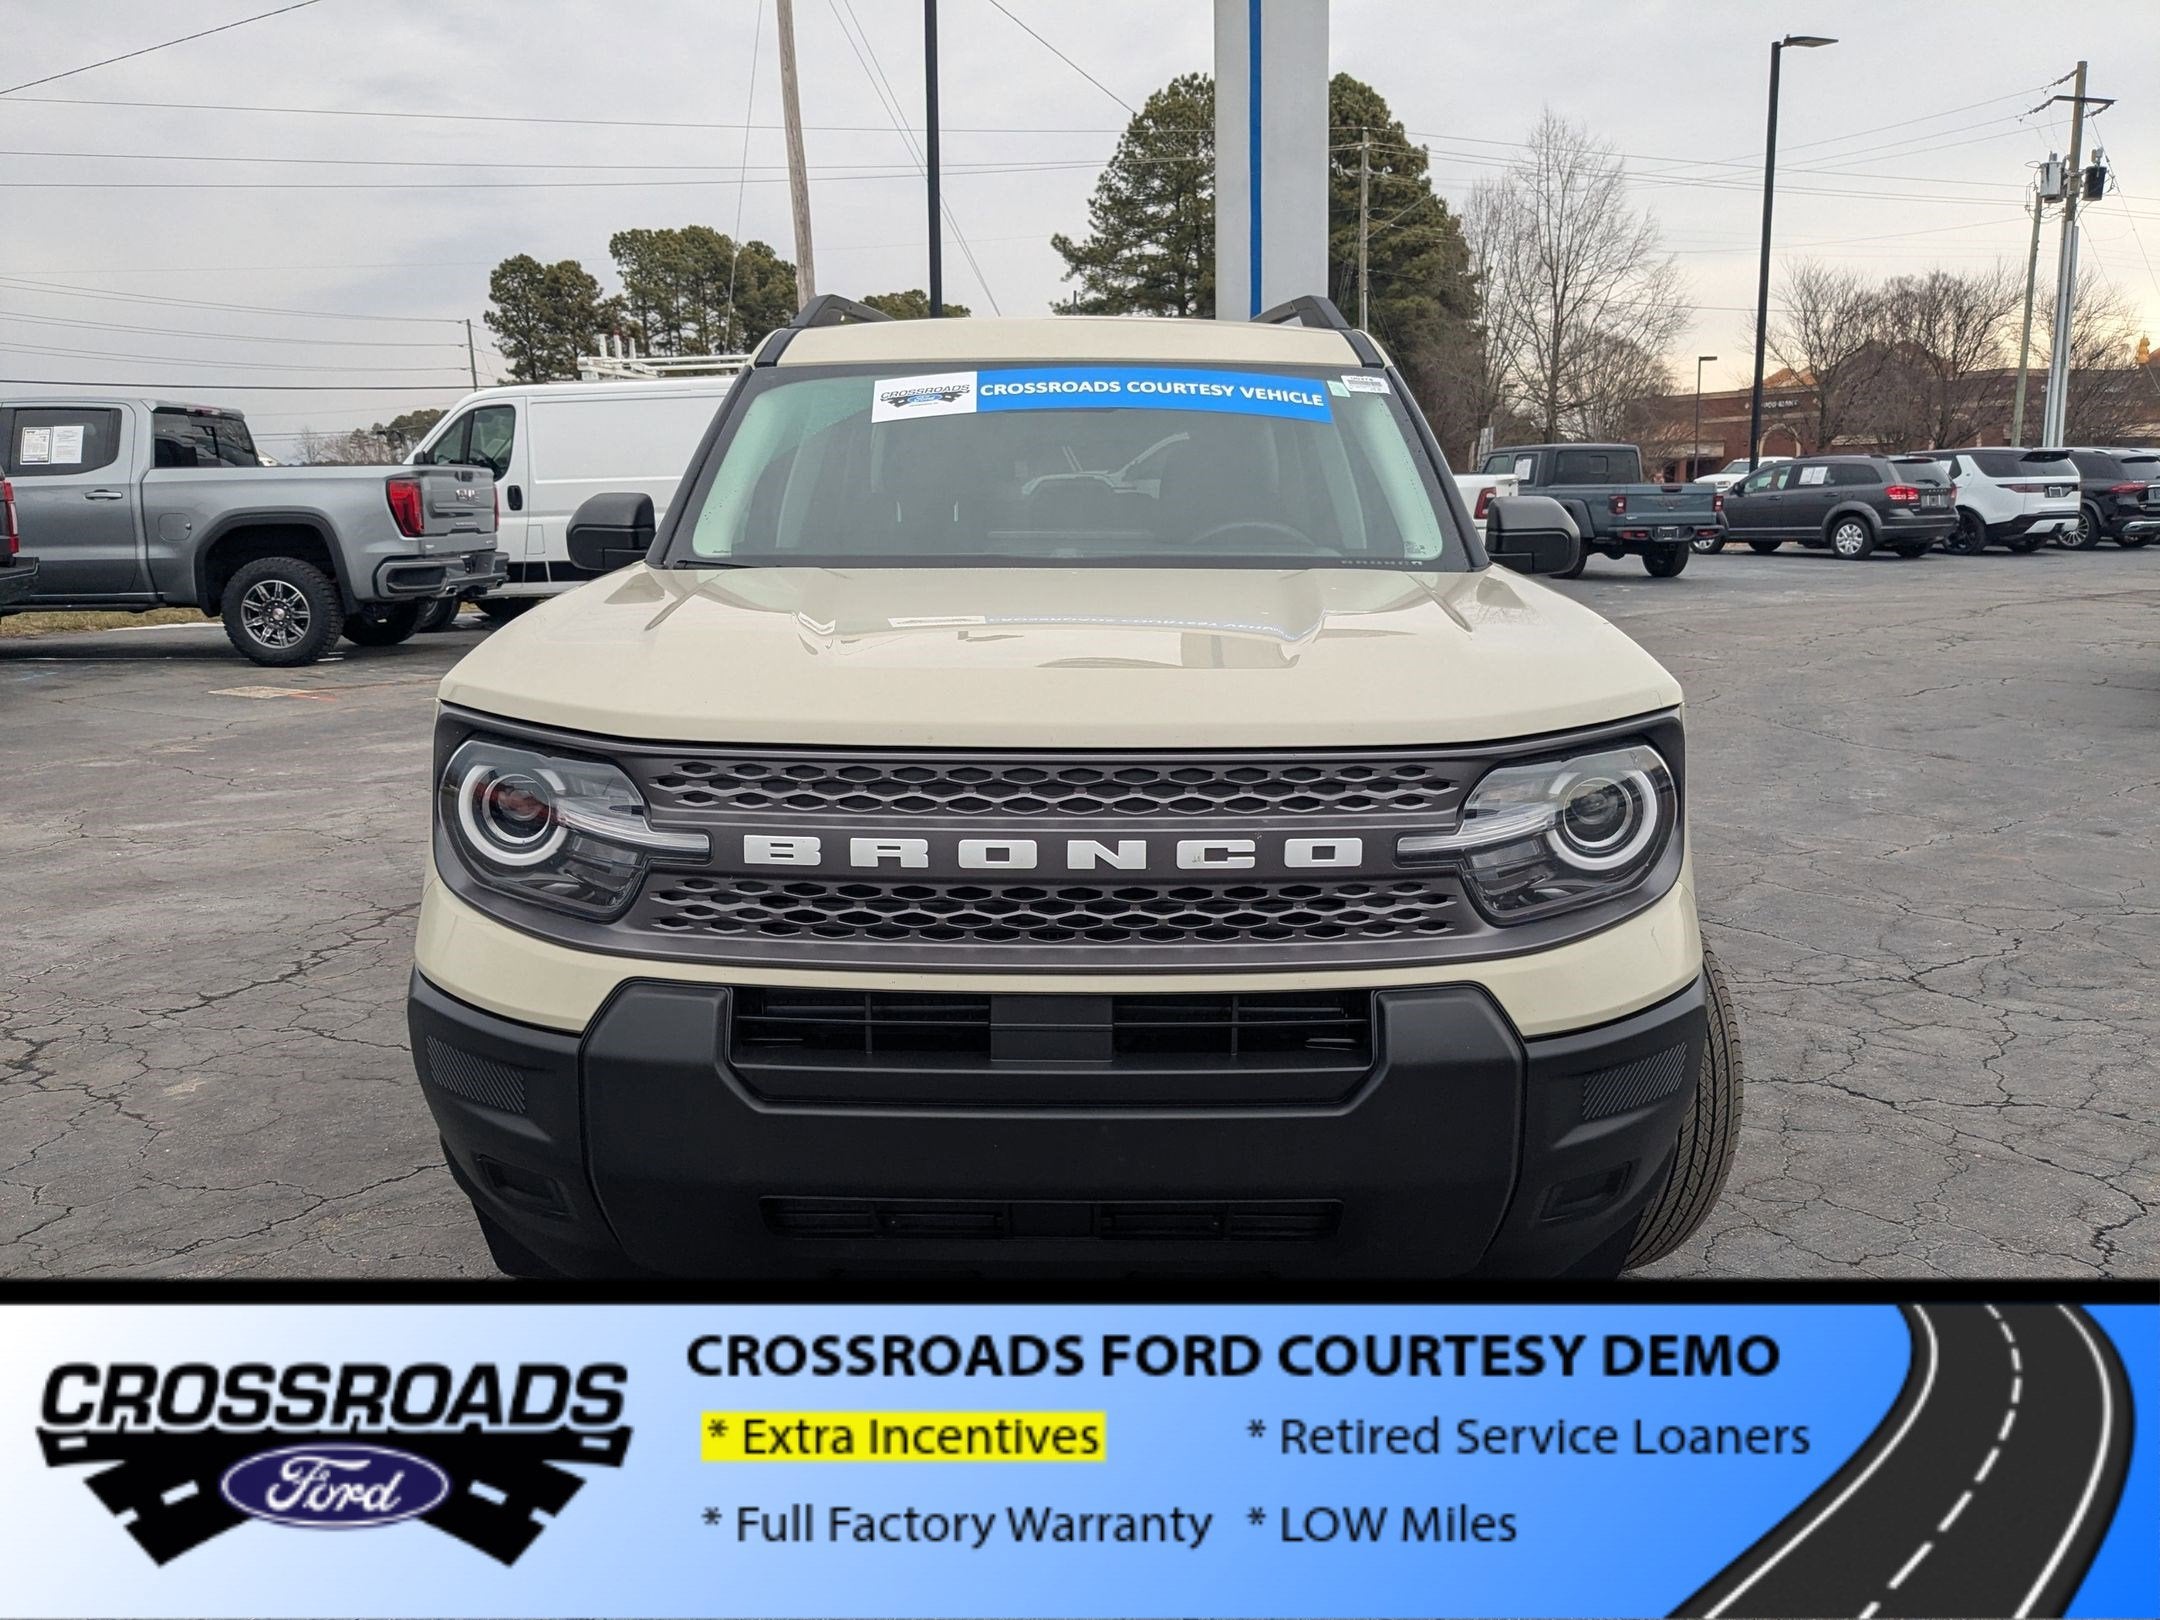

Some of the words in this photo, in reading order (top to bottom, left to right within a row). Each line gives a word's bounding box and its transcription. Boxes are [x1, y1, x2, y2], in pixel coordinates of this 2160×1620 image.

[880, 384, 970, 399] CROSSROADS
[980, 381, 1121, 396] CROSSROADS
[1126, 381, 1234, 398] COURTESY
[1239, 386, 1325, 407] VEHICLE
[744, 834, 1363, 870] BRONCO
